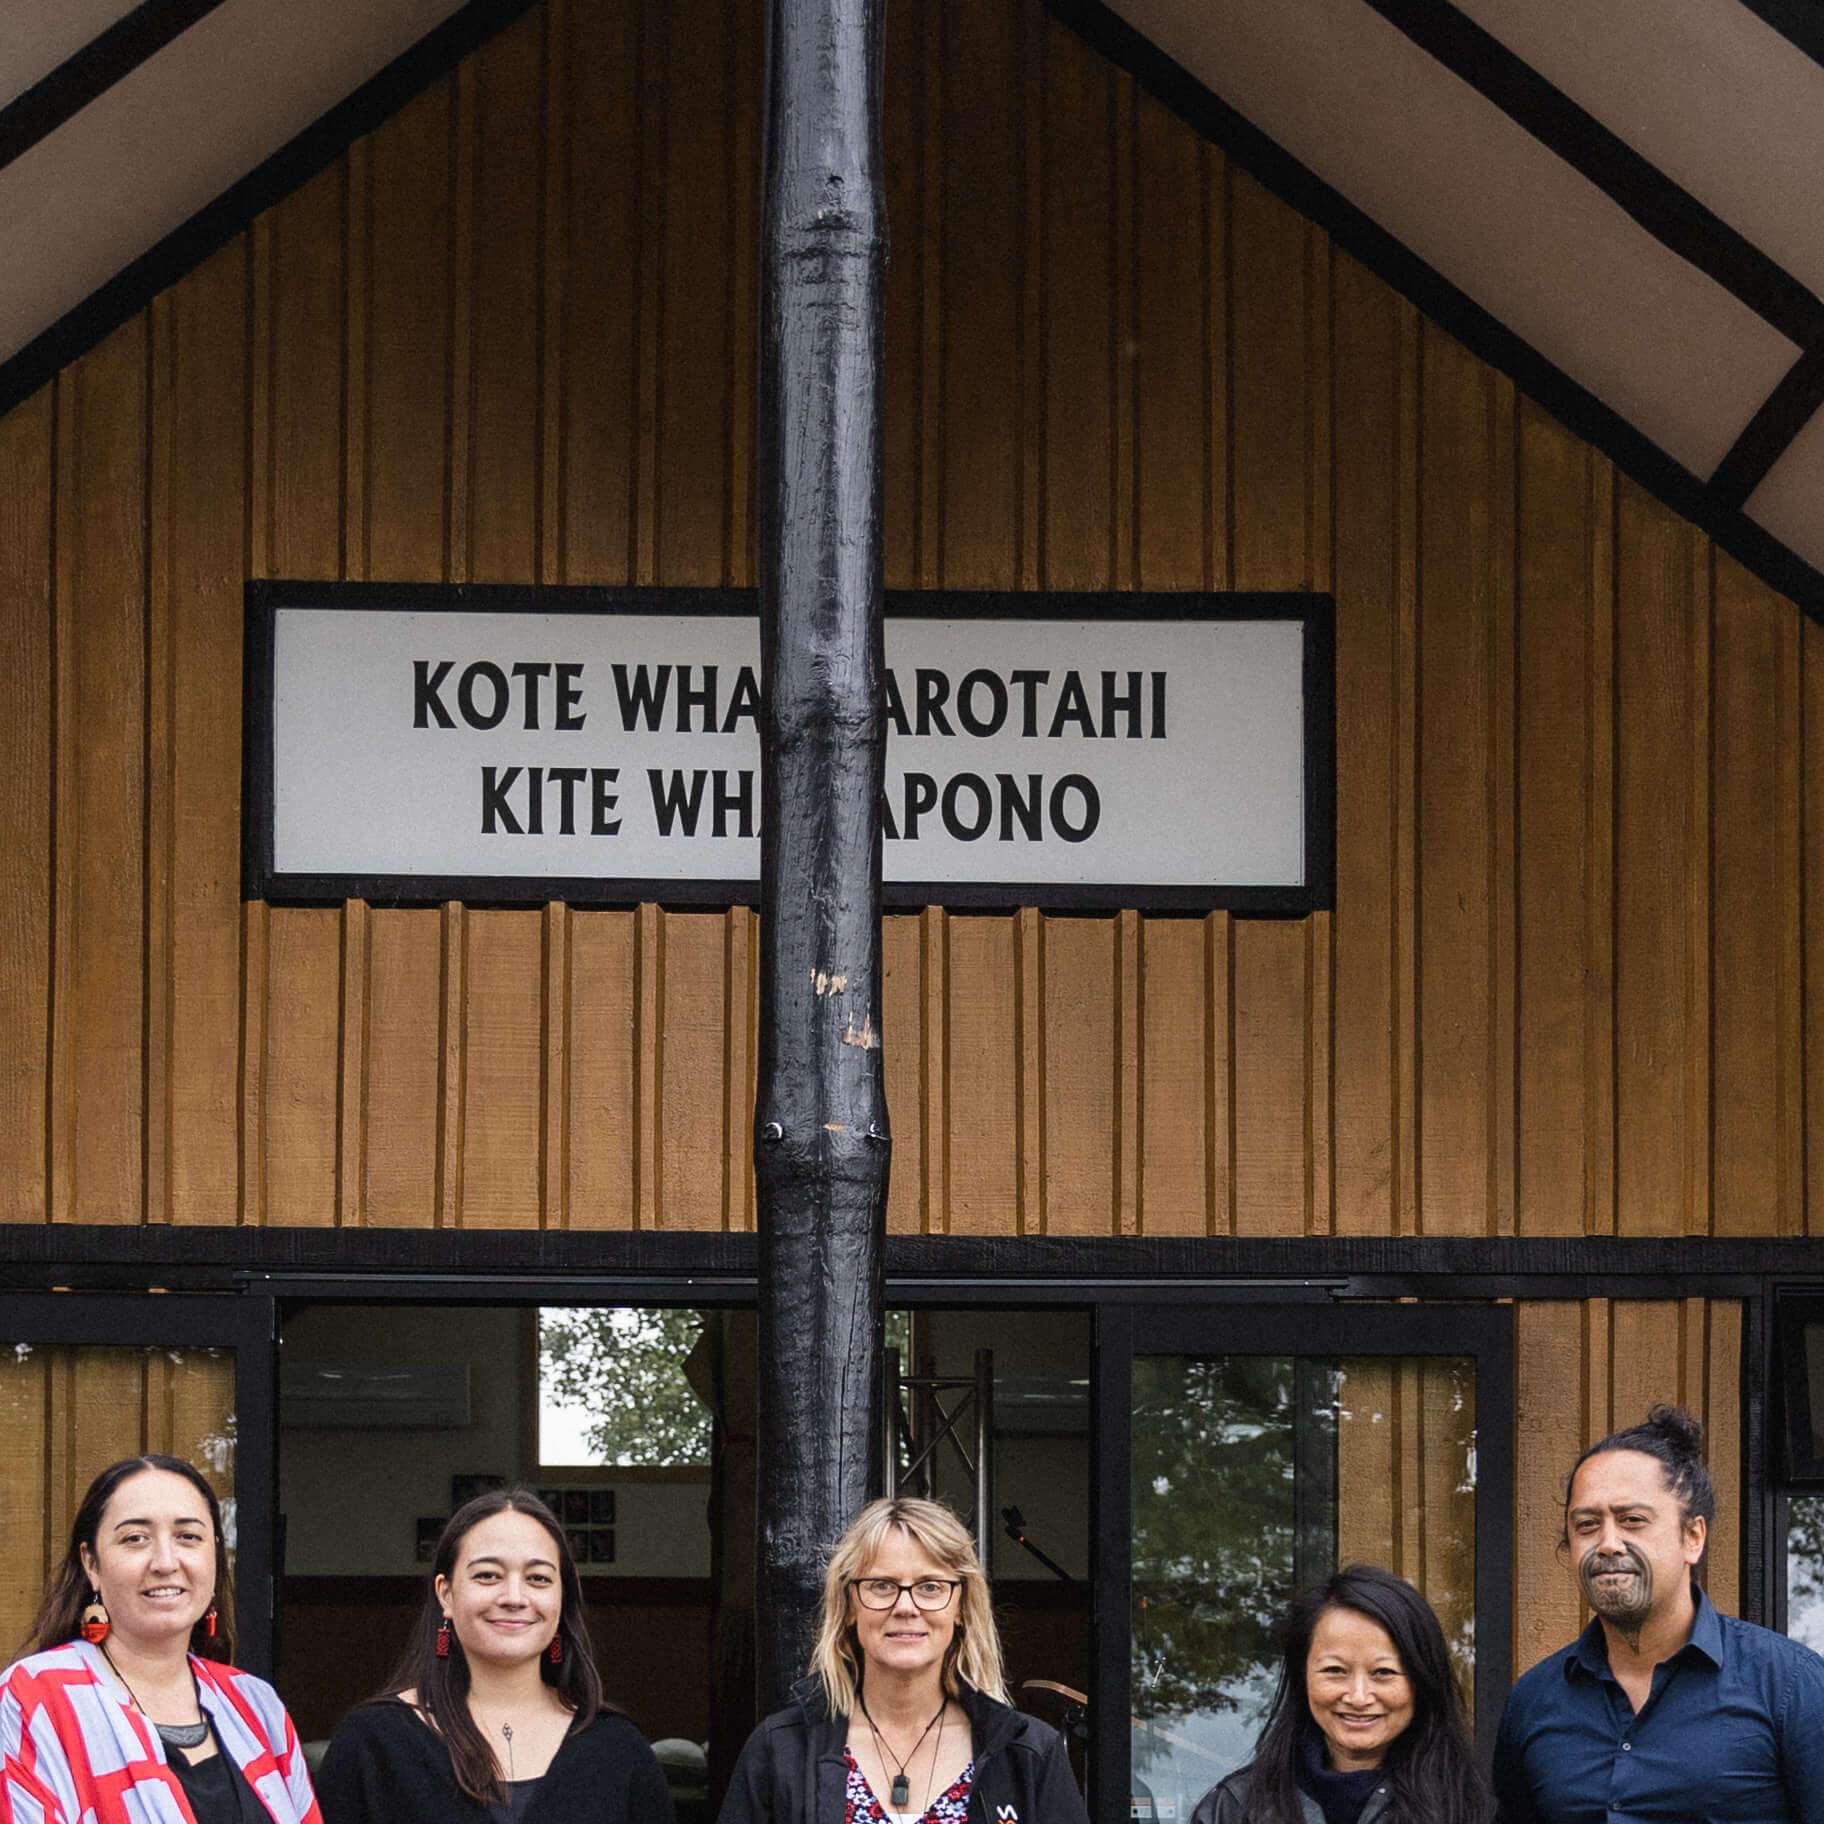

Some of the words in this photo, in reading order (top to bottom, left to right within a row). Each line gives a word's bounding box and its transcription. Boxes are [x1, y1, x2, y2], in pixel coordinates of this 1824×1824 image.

[413, 661, 587, 731] KOTE
[611, 664, 1166, 738] WHAAROTAHI
[482, 767, 622, 836] KITE
[647, 769, 1101, 842] WHPONO
